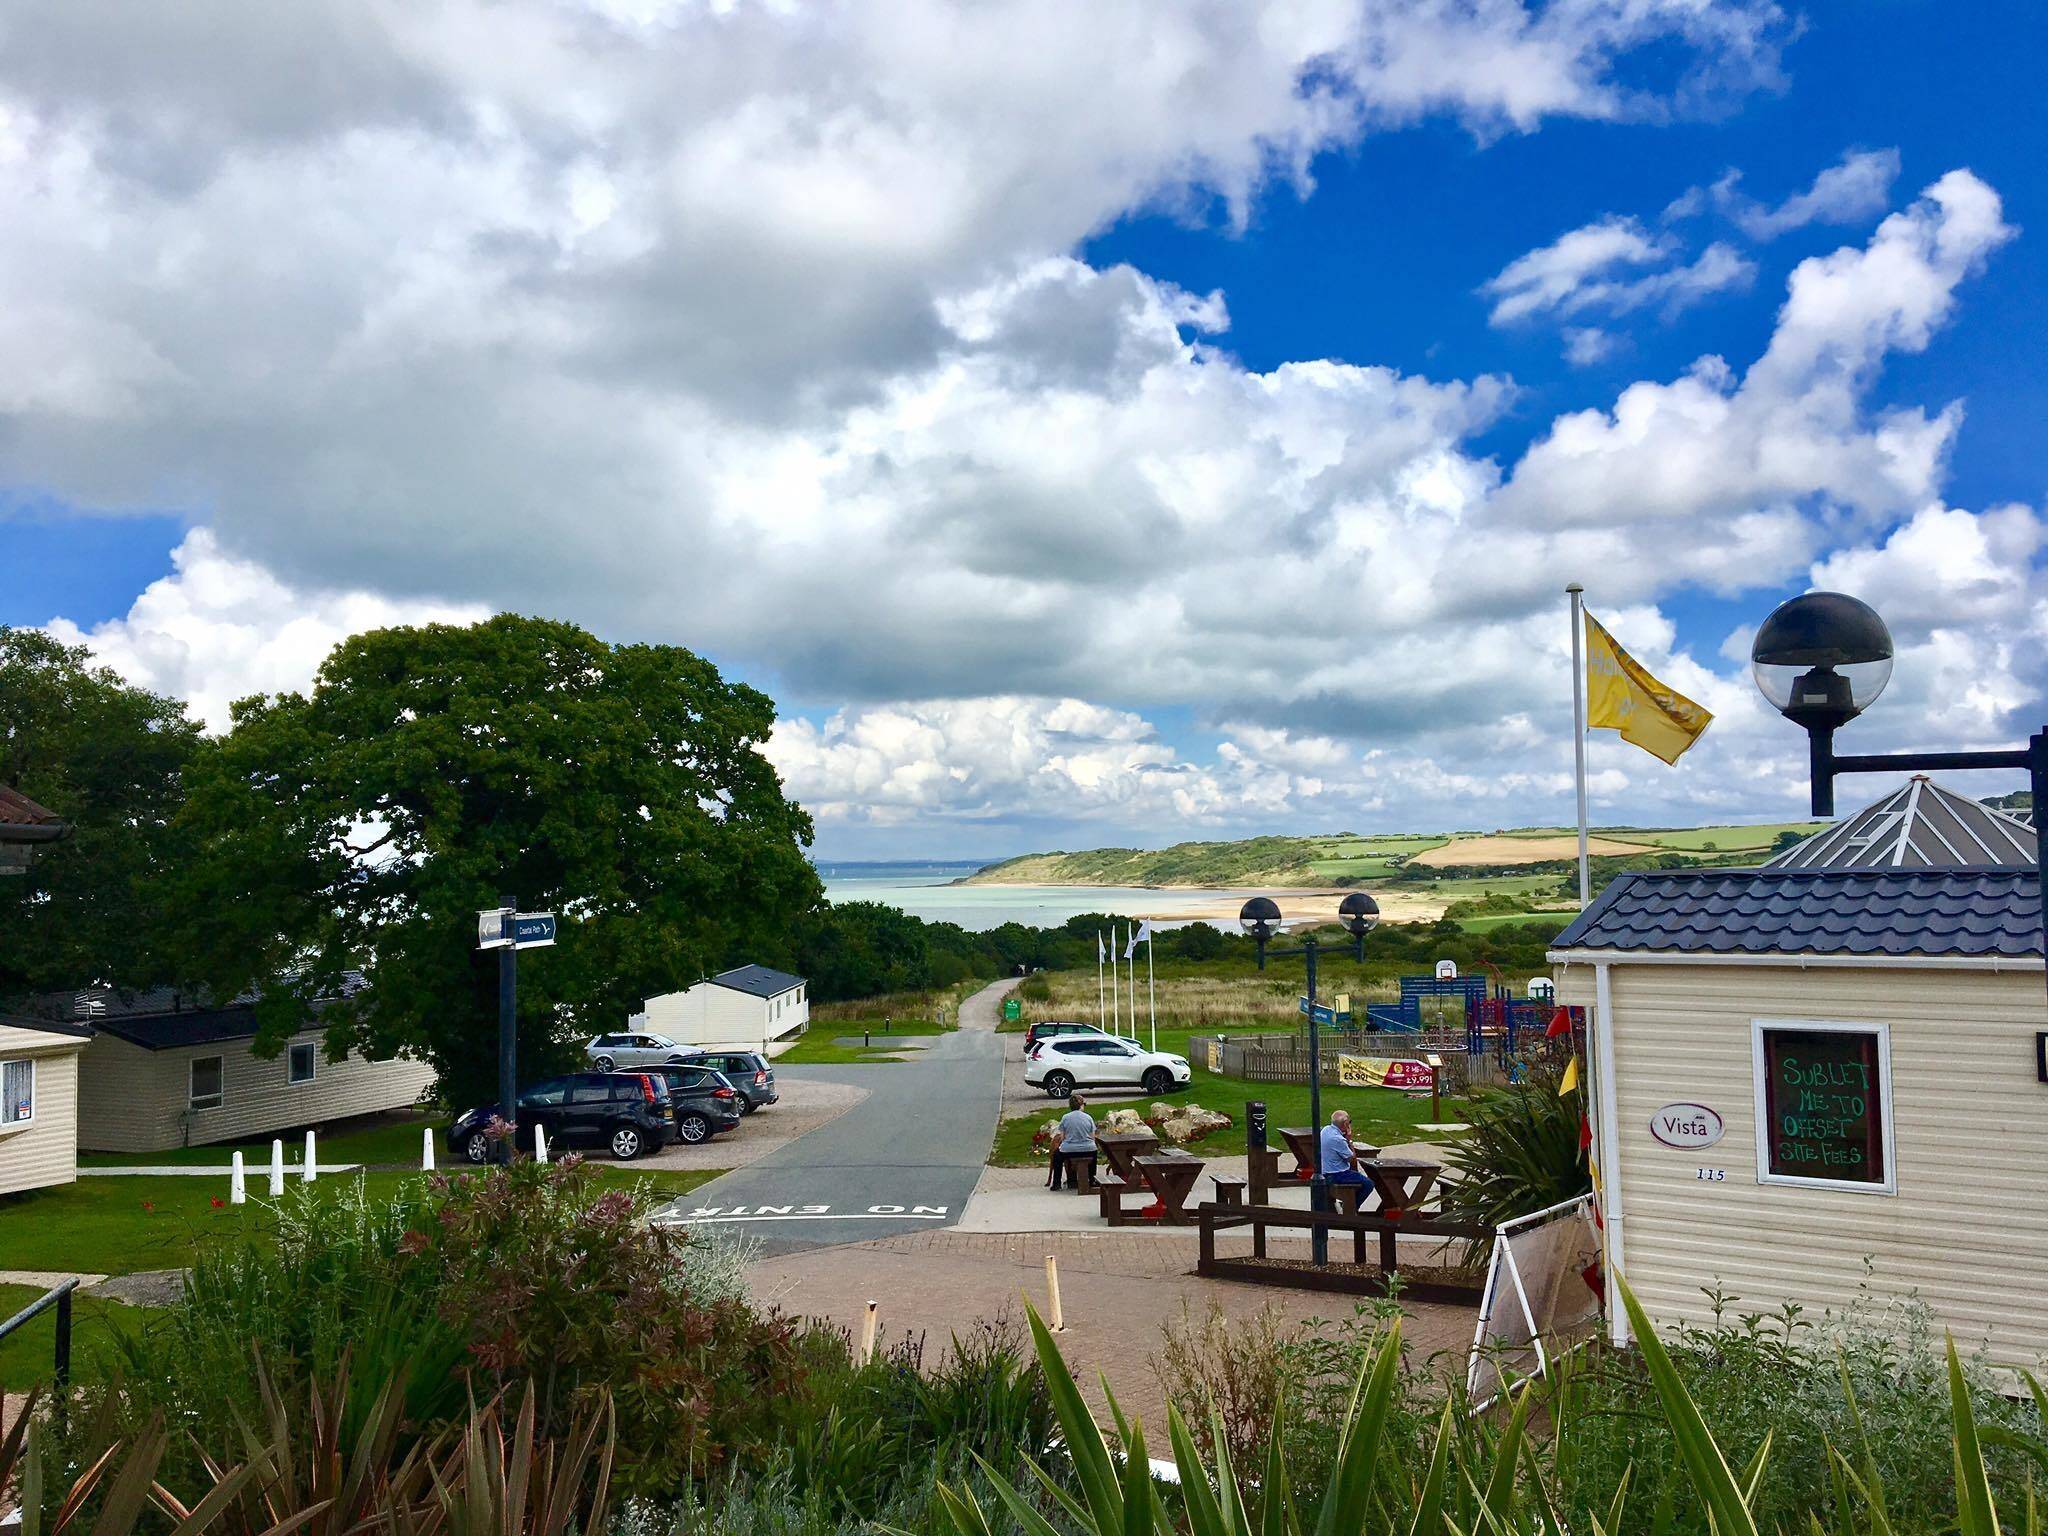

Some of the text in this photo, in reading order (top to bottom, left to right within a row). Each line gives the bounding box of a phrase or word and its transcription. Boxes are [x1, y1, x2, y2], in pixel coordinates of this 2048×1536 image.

[1783, 1057, 1870, 1090] SUBLET
[1799, 1089, 1865, 1117] ME TO
[1663, 1116, 1708, 1136] Vista
[1784, 1115, 1853, 1139] OFFSET
[1779, 1142, 1862, 1166] SITE FEES
[1697, 1168, 1725, 1181] 115
[648, 1205, 949, 1218] NO ENTRY
